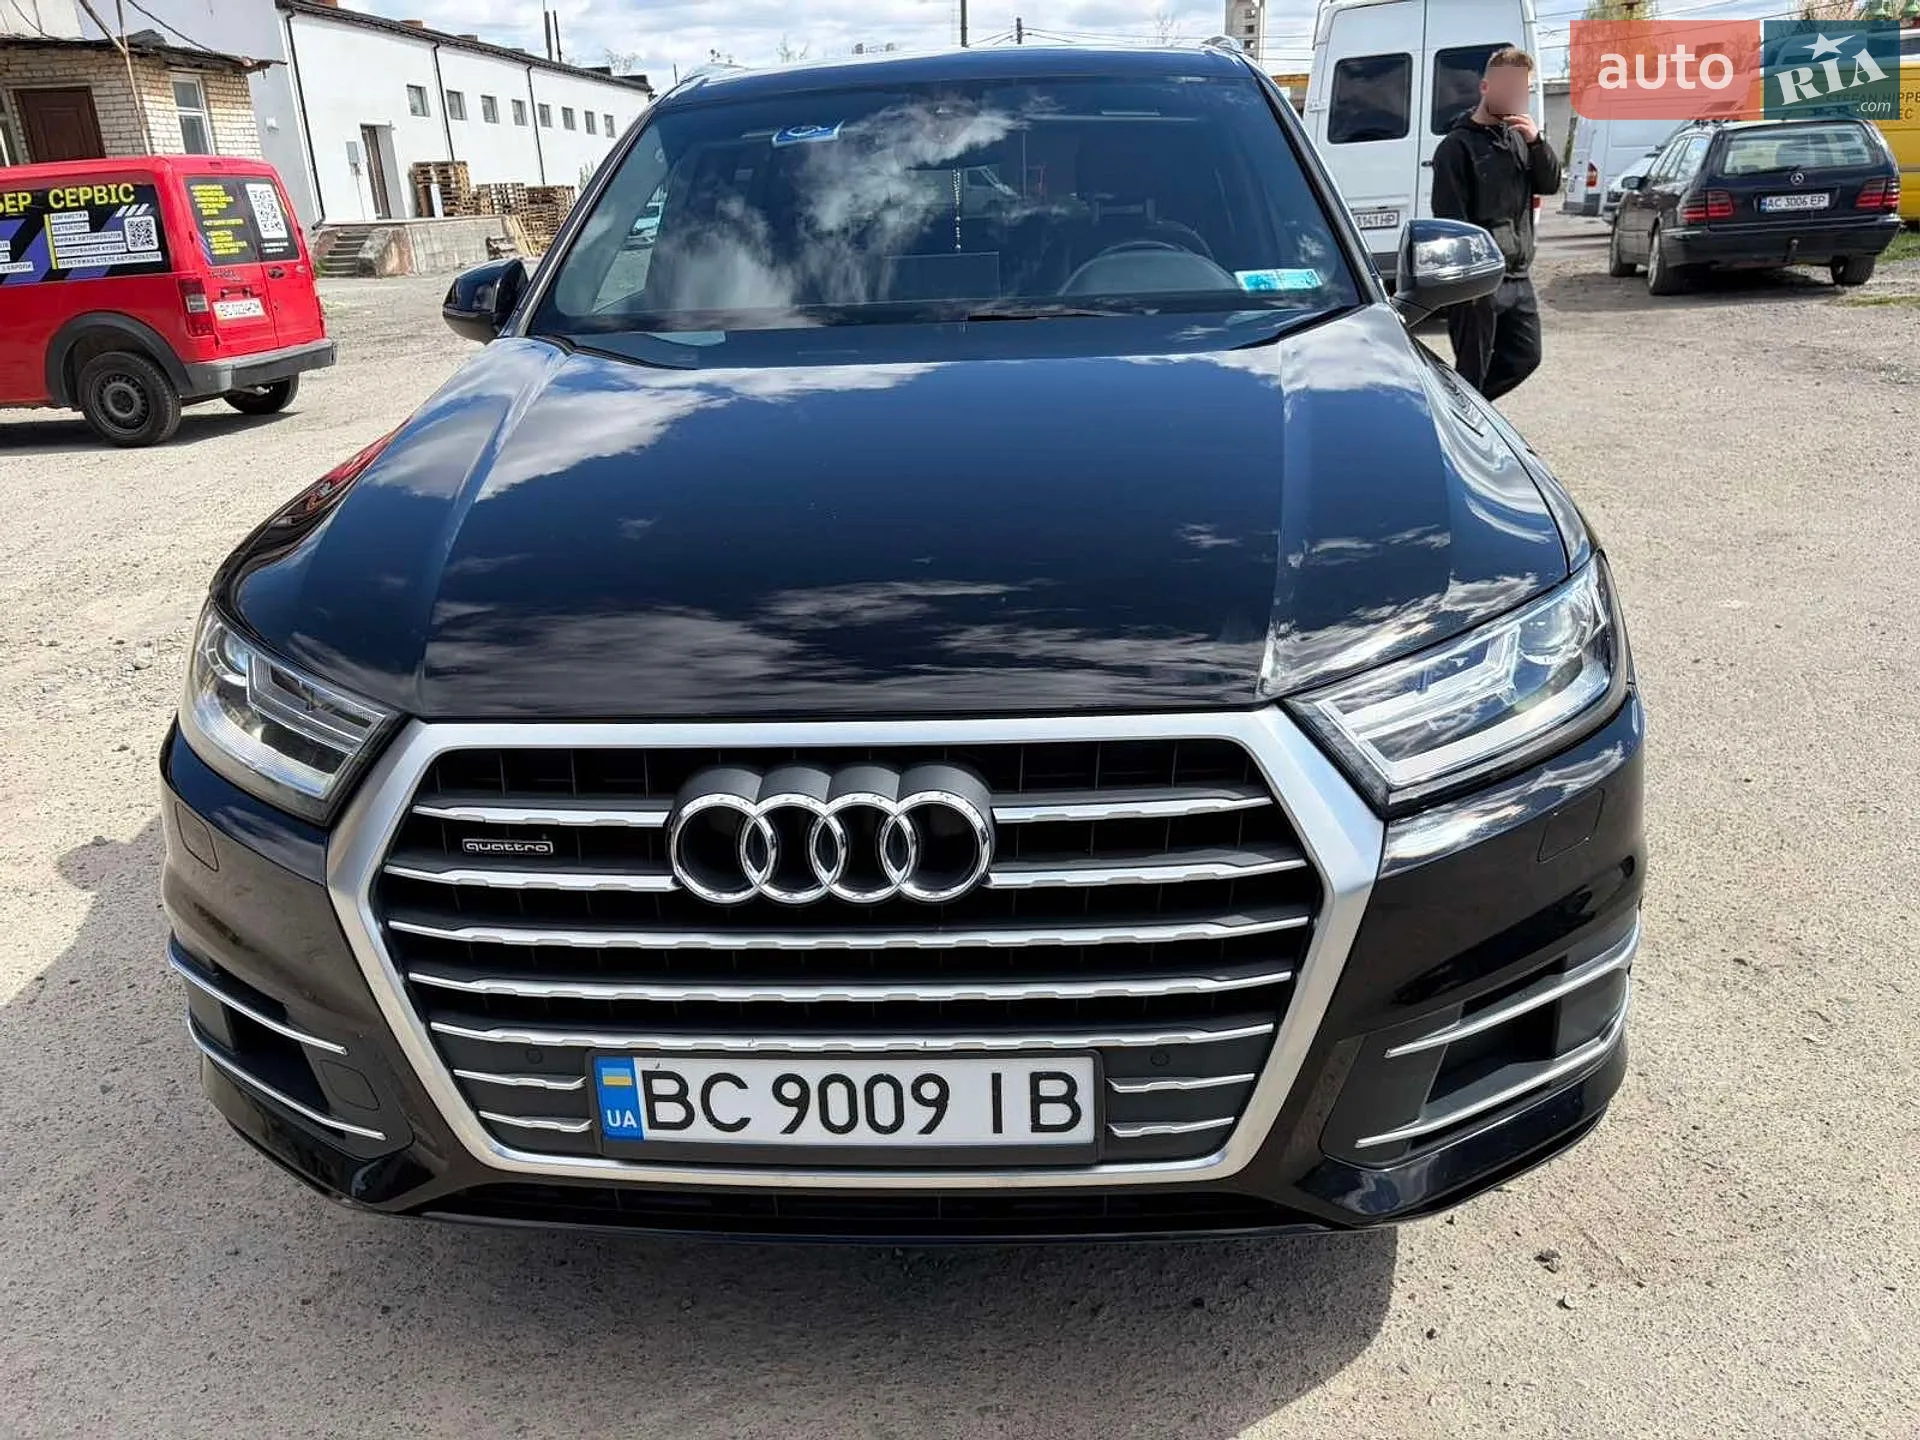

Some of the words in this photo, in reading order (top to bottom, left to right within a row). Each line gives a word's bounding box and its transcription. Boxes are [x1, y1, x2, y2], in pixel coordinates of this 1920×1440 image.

[49, 183, 135, 209] СЕРВІС
[1767, 198, 1782, 208] AC
[466, 842, 549, 852] quattro
[606, 1109, 638, 1129] UA
[642, 1069, 752, 1133] BC
[772, 1072, 950, 1135] 9009
